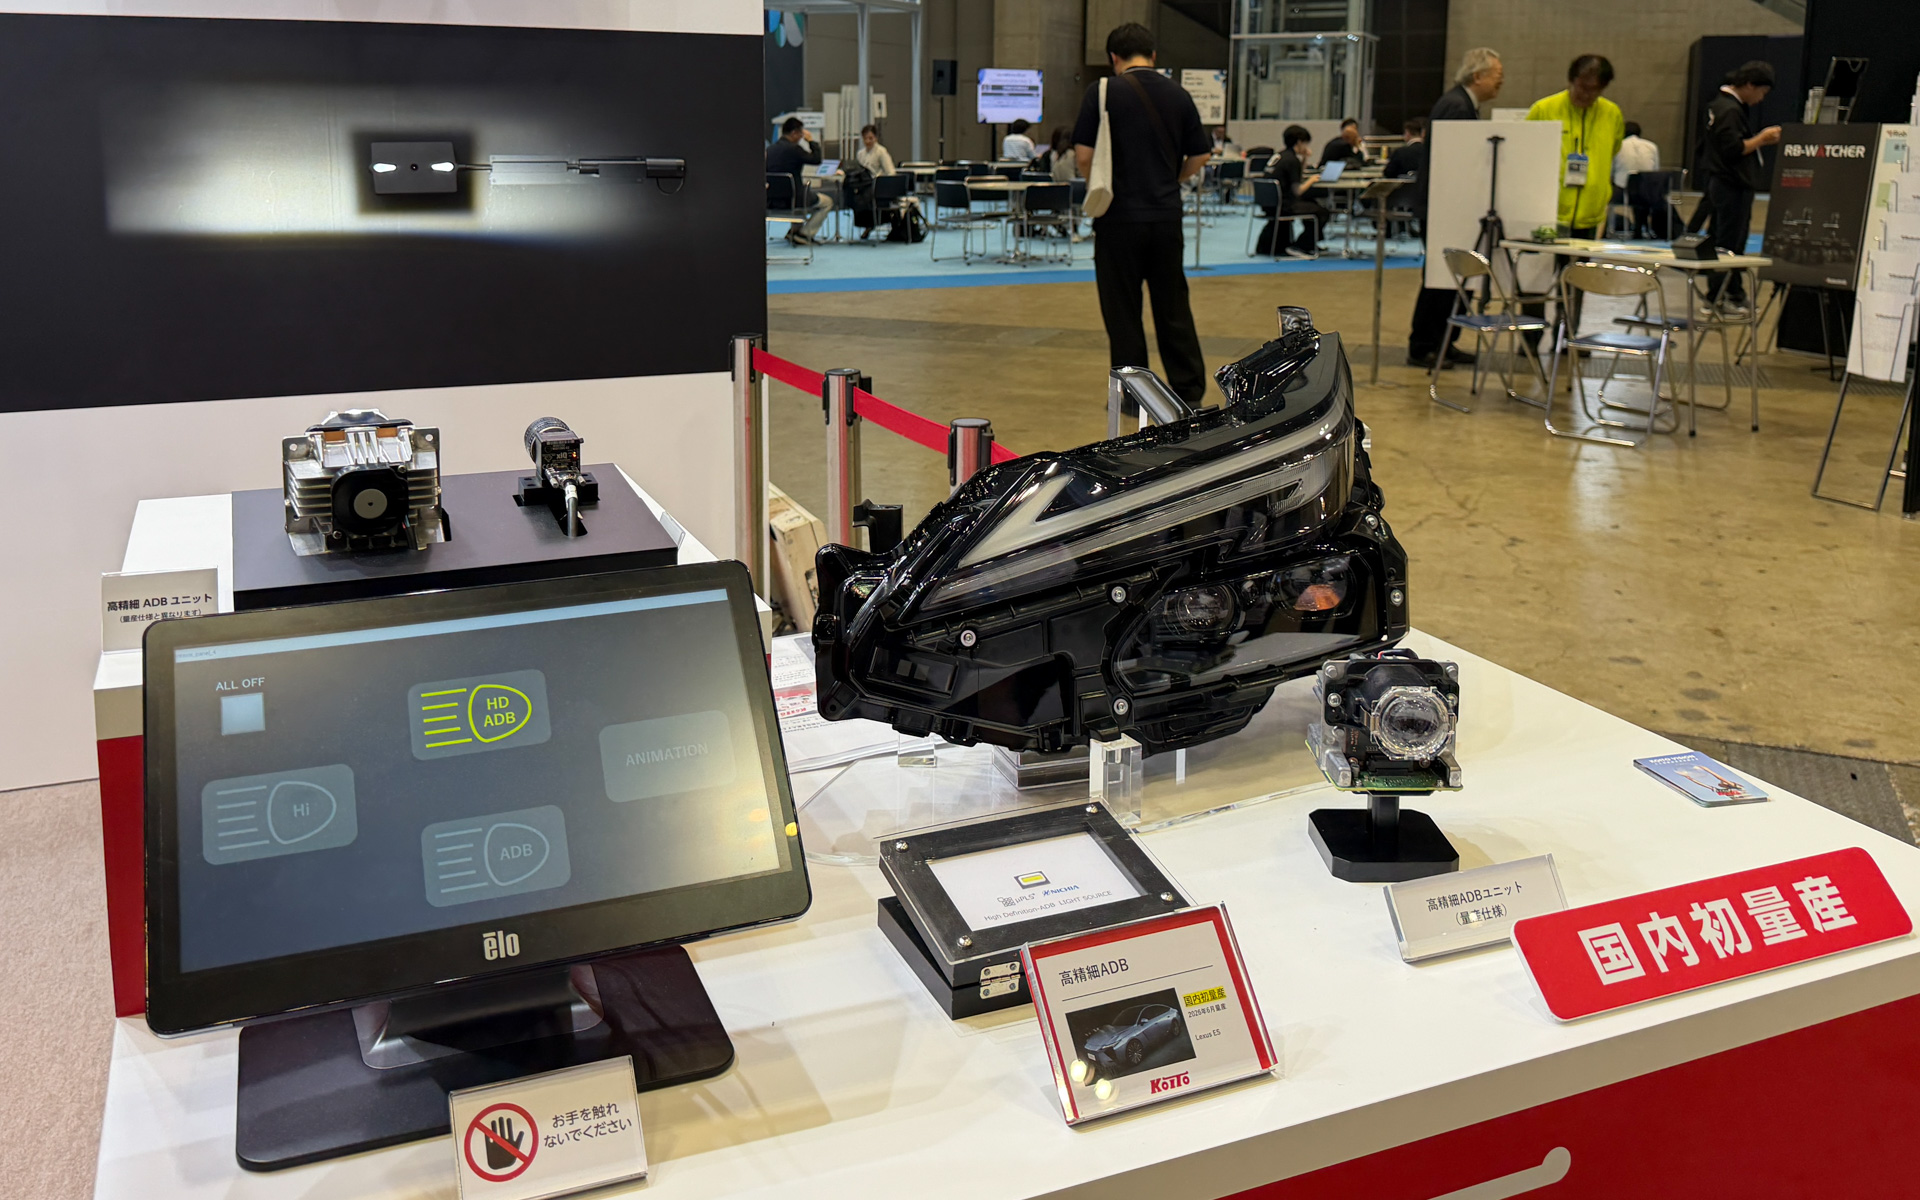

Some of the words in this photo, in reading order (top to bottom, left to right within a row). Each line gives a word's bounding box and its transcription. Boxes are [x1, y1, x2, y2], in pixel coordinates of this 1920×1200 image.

[1783, 143, 1867, 159] RB-WATCHER
[107, 599, 140, 612] 高精細
[143, 597, 168, 608] ADB
[171, 593, 212, 605] ユニット
[215, 680, 238, 692] ALL
[242, 677, 265, 689] OFF
[486, 696, 510, 711] HD
[483, 711, 516, 728] ADB
[625, 742, 709, 768] ANIMATION
[293, 803, 310, 817] Hi
[500, 843, 533, 861] ADB
[1050, 885, 1079, 894] NICHIA
[1426, 880, 1523, 912] 高精細ADBユニット
[984, 913, 1002, 922] High
[1002, 902, 1056, 918] Definition-ADB
[1059, 897, 1081, 906] LIGHT
[1083, 891, 1112, 901] SOURCE
[1577, 875, 1857, 986] 国内初量産
[1058, 958, 1129, 987] 高精細ADB
[1183, 987, 1226, 1007] 国内初量産
[1188, 1003, 1227, 1018] 2026年6月量産
[1195, 1032, 1213, 1041] Lexus
[552, 1102, 620, 1128] お手を触れ
[543, 1117, 632, 1148] ないでください
